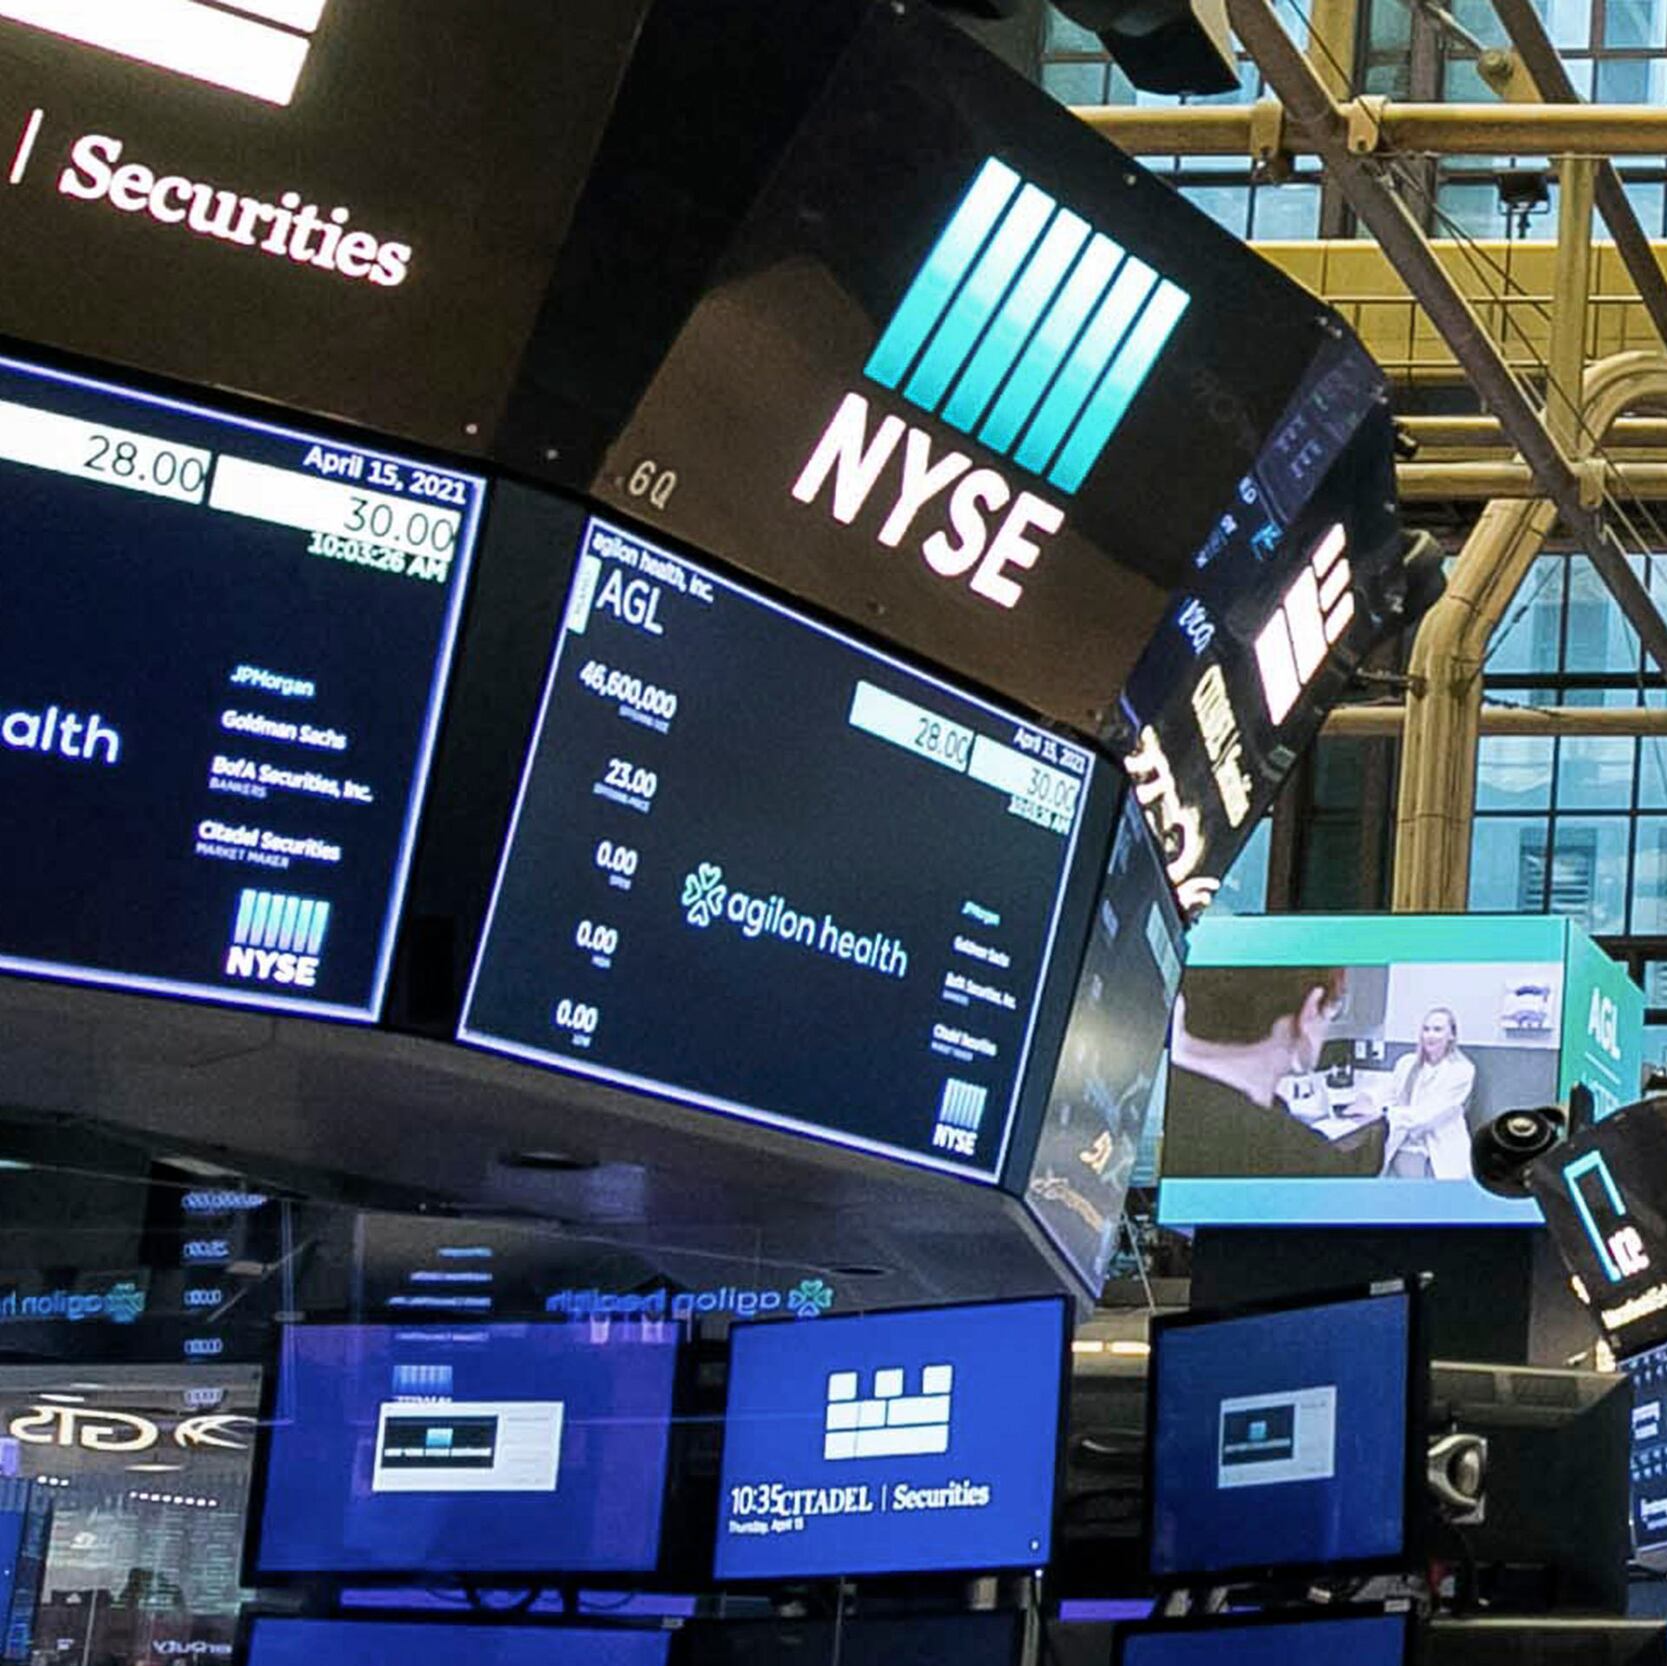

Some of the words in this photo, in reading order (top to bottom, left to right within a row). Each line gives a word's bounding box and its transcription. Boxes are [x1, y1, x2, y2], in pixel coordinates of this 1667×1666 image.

[59, 134, 411, 286] Securities
[84, 436, 205, 493] 28.00
[304, 445, 362, 484] April
[367, 460, 402, 490] 15,
[409, 469, 467, 503] 2021
[792, 392, 1064, 609] NYSE
[345, 497, 455, 551] 30.00
[408, 551, 447, 583] AM
[596, 569, 663, 635] AGL
[604, 758, 657, 797] 23.00
[597, 841, 638, 875] 0.00
[576, 920, 618, 954] 0.00
[727, 889, 817, 946] agilon
[820, 915, 907, 978] health
[225, 946, 320, 987] NYSE
[556, 999, 597, 1033] 0.00
[1588, 986, 1621, 1061] AGL
[932, 1123, 977, 1156] NYSE
[731, 1483, 783, 1515] 10:35
[777, 1485, 873, 1517] CITADEL
[893, 1479, 990, 1511] Securities
